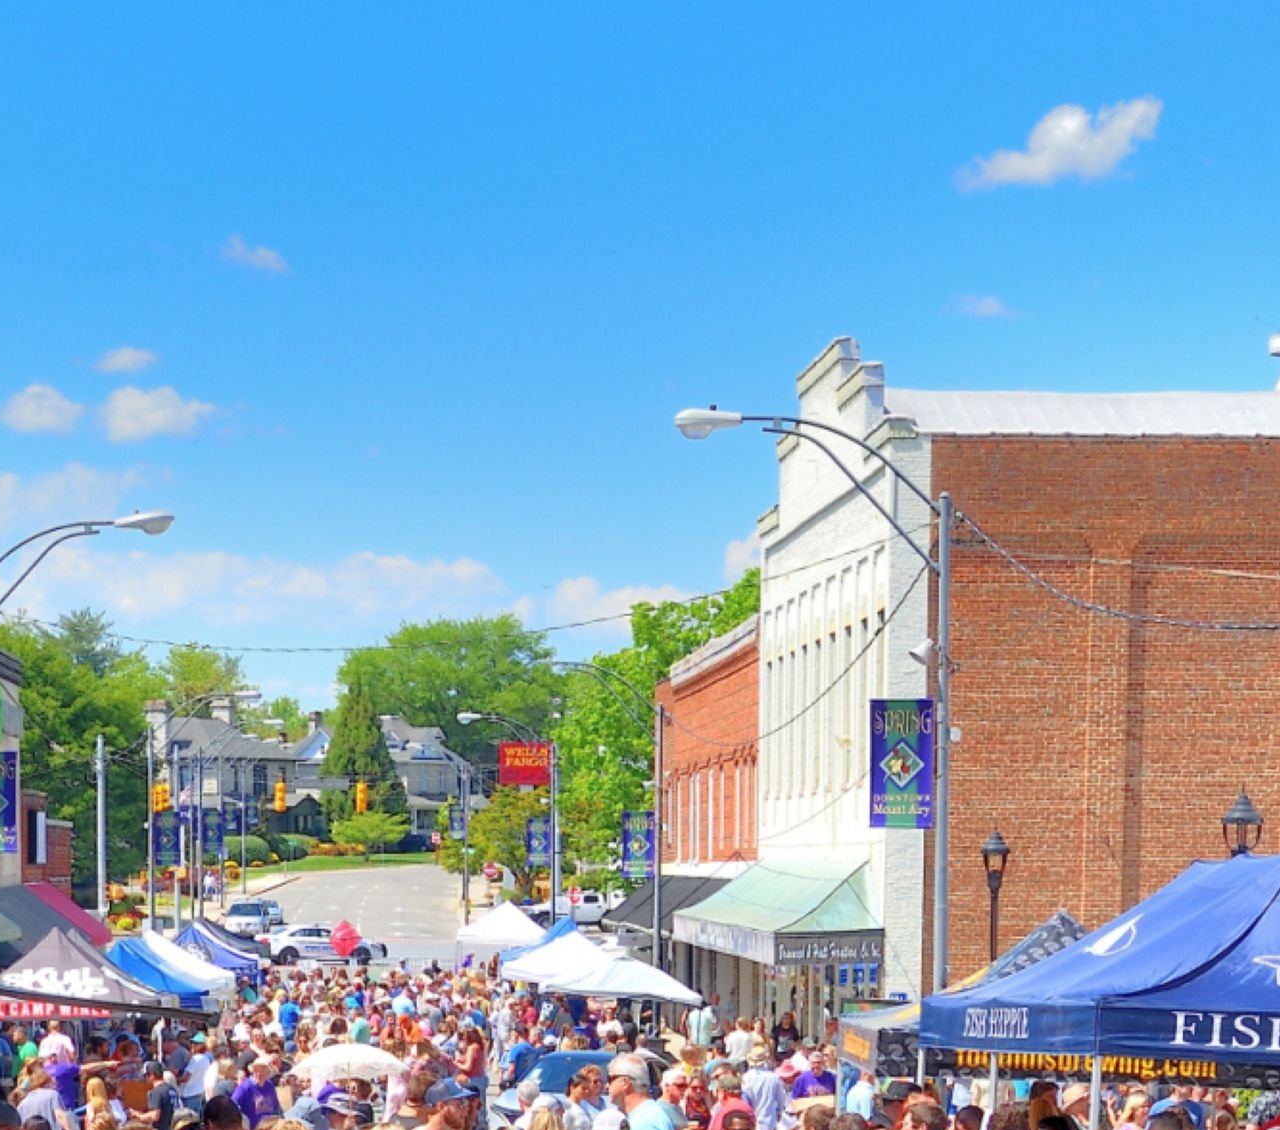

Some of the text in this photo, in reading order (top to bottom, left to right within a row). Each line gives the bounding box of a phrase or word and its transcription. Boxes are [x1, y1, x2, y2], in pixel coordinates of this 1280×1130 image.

[873, 709, 932, 739] SPRING
[505, 747, 548, 756] WELLS
[506, 757, 548, 766] FARGO
[873, 794, 930, 802] DOWNTOWN
[872, 804, 930, 818] Mount Airy
[9, 1003, 55, 1017] CAMP
[59, 1005, 110, 1017] WINE
[963, 1007, 1029, 1039] FISH HIPPIE
